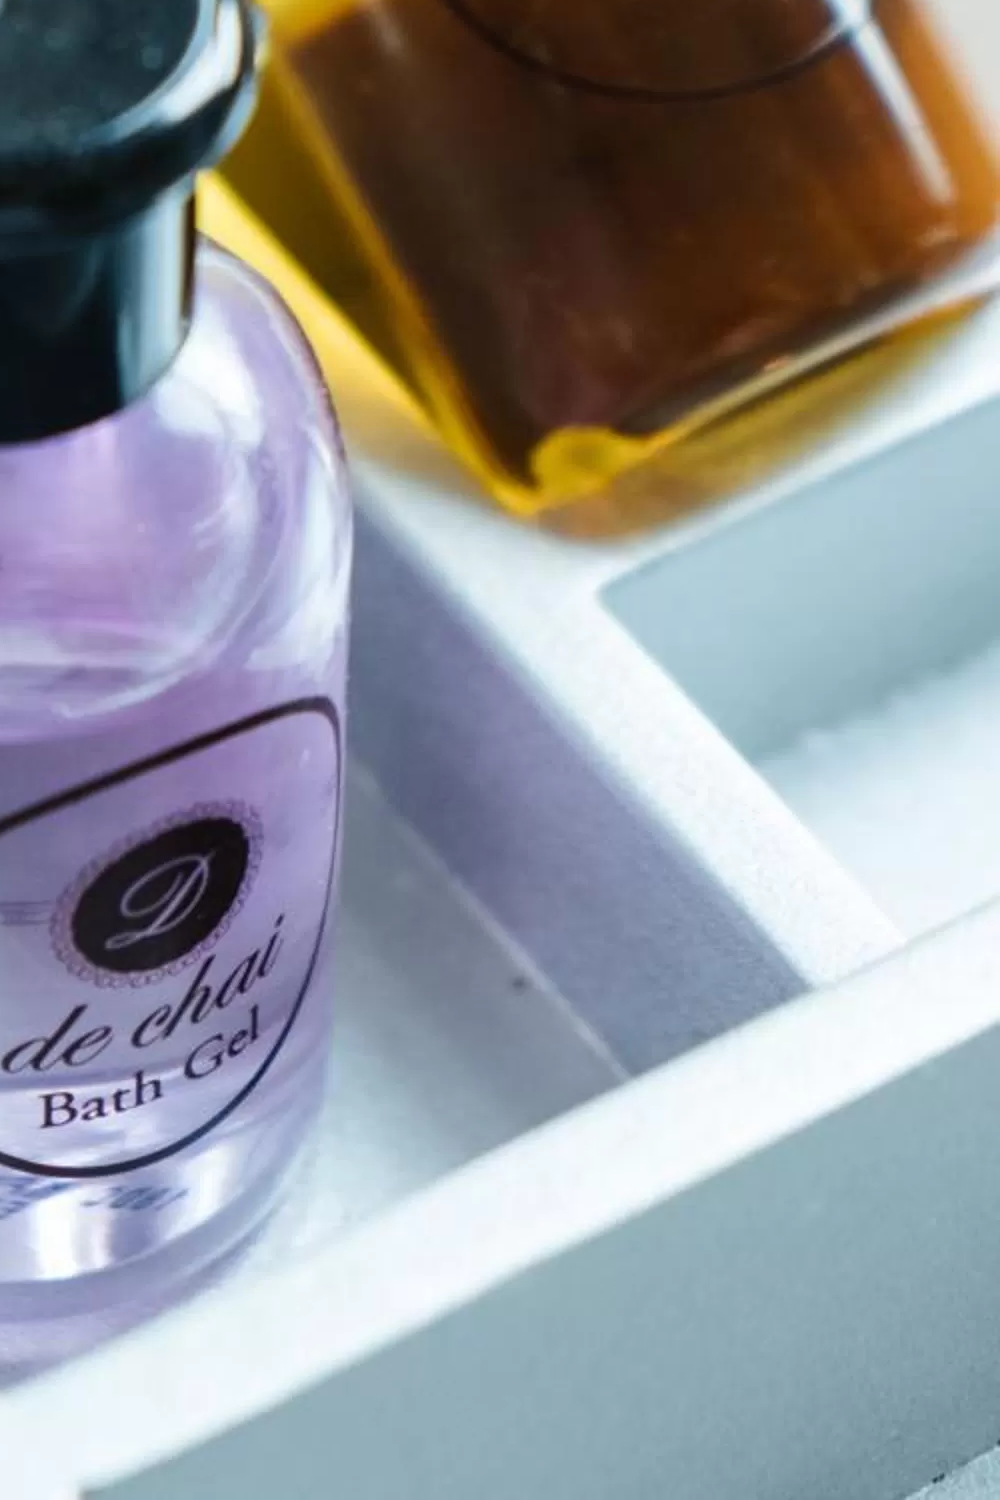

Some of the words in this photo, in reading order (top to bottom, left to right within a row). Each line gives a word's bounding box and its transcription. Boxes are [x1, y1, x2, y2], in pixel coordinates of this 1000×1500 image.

[103, 851, 217, 950] D
[1, 1003, 113, 1074] de
[131, 914, 284, 1048] chai
[39, 1069, 164, 1129] Bath
[184, 1005, 259, 1080] Gel
